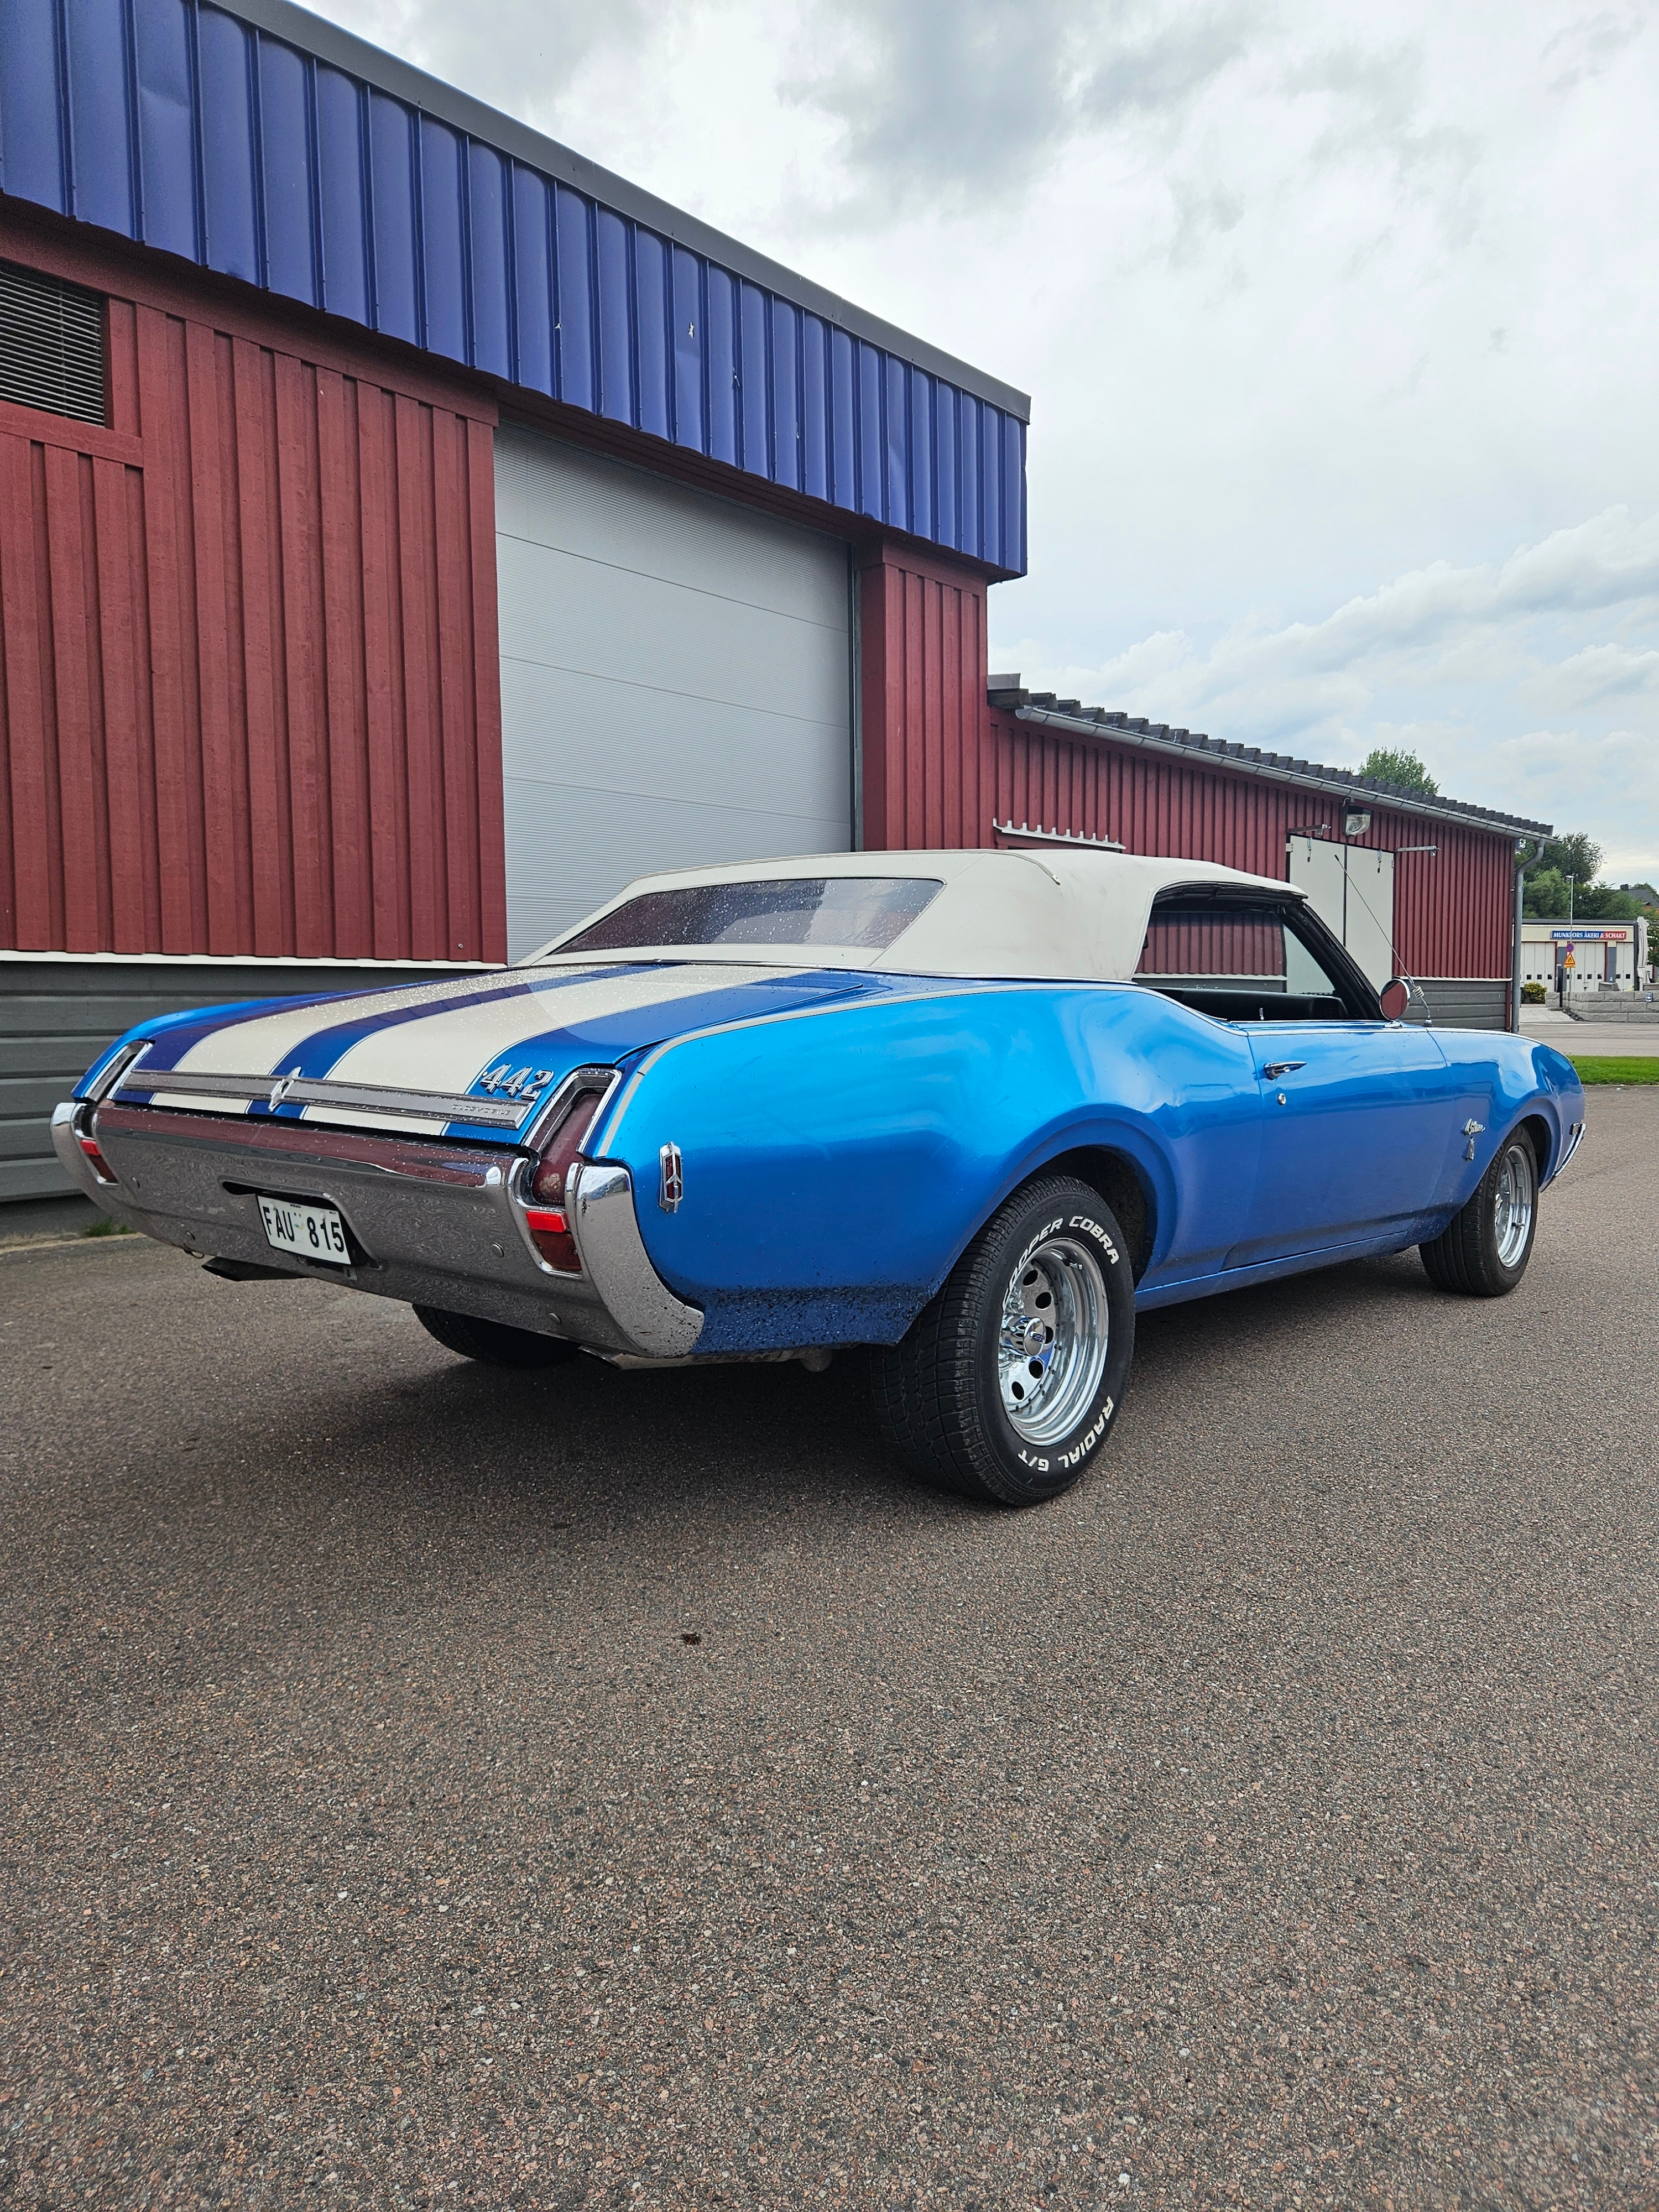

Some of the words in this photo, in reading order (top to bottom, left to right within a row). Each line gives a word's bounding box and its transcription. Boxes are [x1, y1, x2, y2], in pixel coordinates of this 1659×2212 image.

[479, 1064, 554, 1101] 442
[451, 1104, 511, 1115] OLDSMOBILE
[262, 1206, 295, 1242] FAU
[307, 1217, 345, 1253] 815
[1068, 1215, 1120, 1265] COBRA
[1057, 1396, 1114, 1468] RADIAL
[1018, 1449, 1049, 1472] G/T
